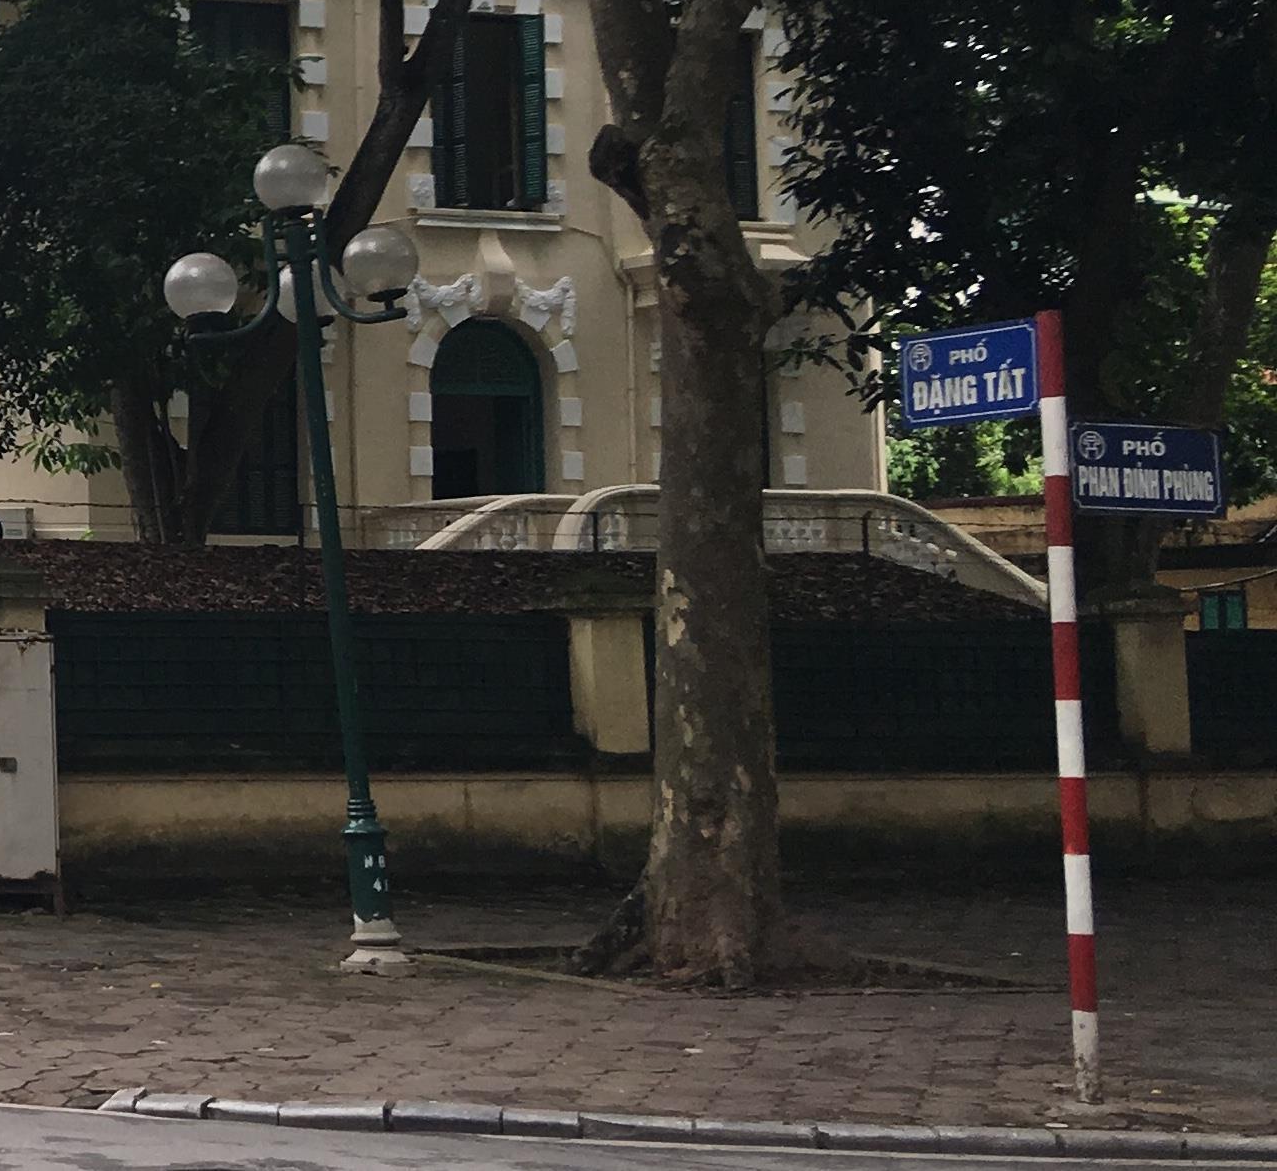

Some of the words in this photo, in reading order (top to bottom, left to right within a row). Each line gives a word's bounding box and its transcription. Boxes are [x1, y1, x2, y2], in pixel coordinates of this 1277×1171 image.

[949, 338, 987, 365] PHỐ
[913, 373, 978, 415] ĐẶNG
[983, 358, 1027, 402] TẤT
[1122, 431, 1166, 457] PHỐ
[1078, 465, 1120, 498] PHAN
[1163, 463, 1214, 502] PHÙNG
